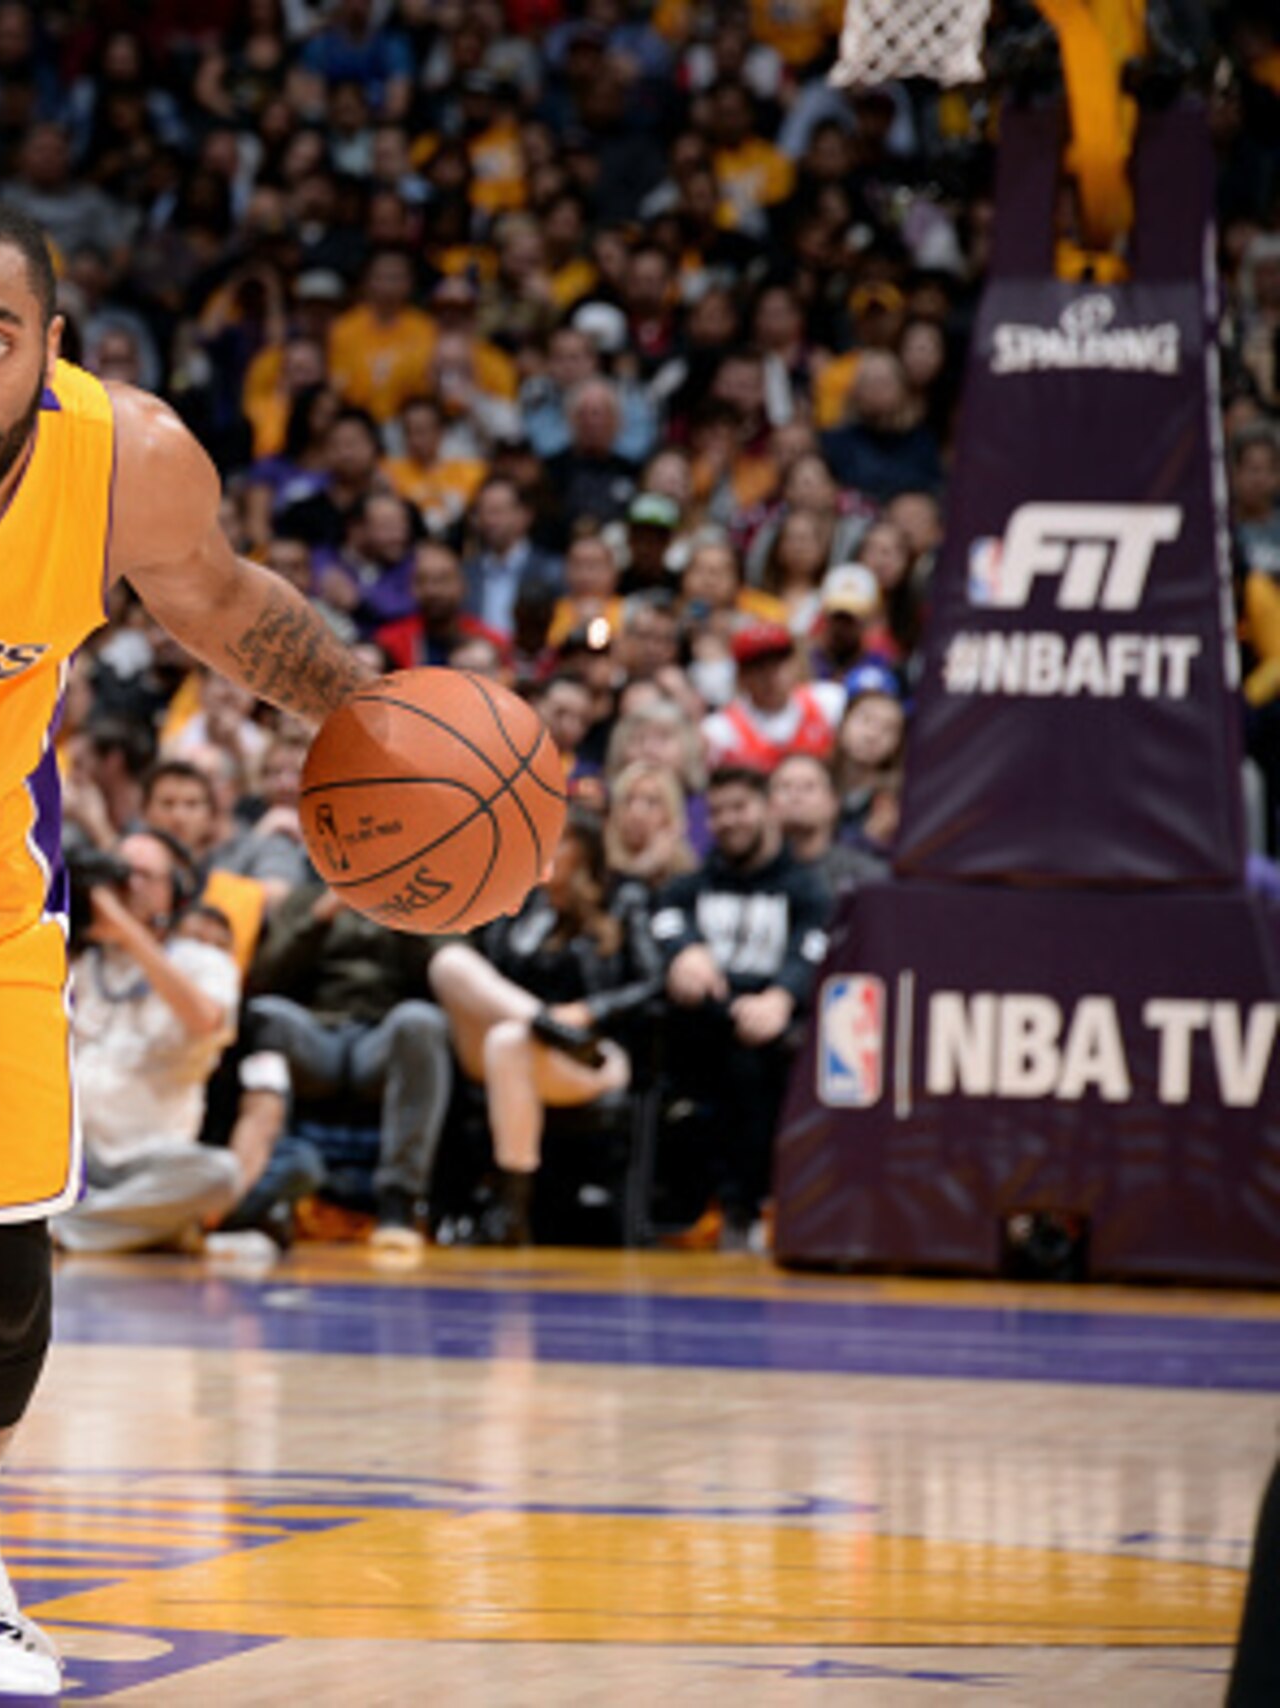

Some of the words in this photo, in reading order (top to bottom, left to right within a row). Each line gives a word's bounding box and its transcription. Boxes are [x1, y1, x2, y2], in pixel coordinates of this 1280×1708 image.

[991, 322, 1180, 375] SPALDING
[943, 630, 1201, 698] #NBAFIT
[926, 991, 1132, 1102] NBA
[1143, 999, 1280, 1106] TV
